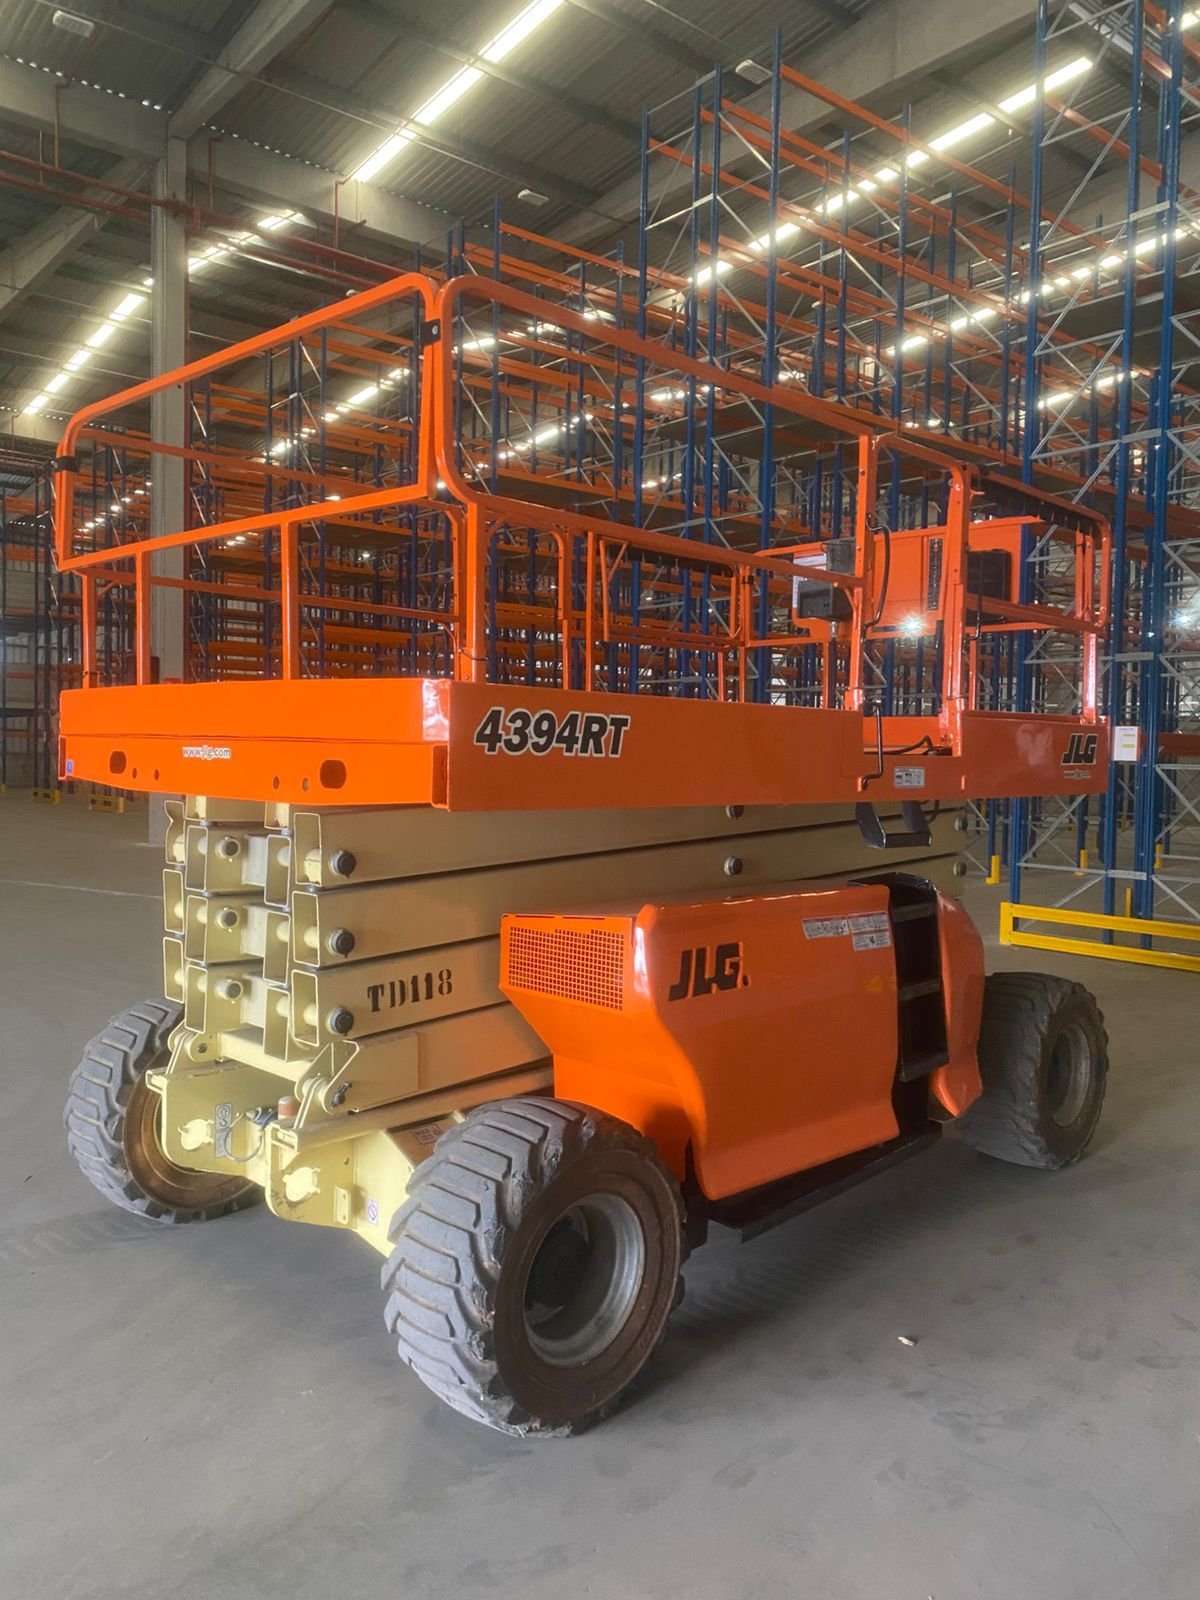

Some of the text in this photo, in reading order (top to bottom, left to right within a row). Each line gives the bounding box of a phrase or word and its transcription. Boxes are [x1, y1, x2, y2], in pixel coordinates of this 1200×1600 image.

[474, 706, 631, 758] 4394RT
[1061, 733, 1099, 765] JLG
[367, 969, 452, 1012] TD118
